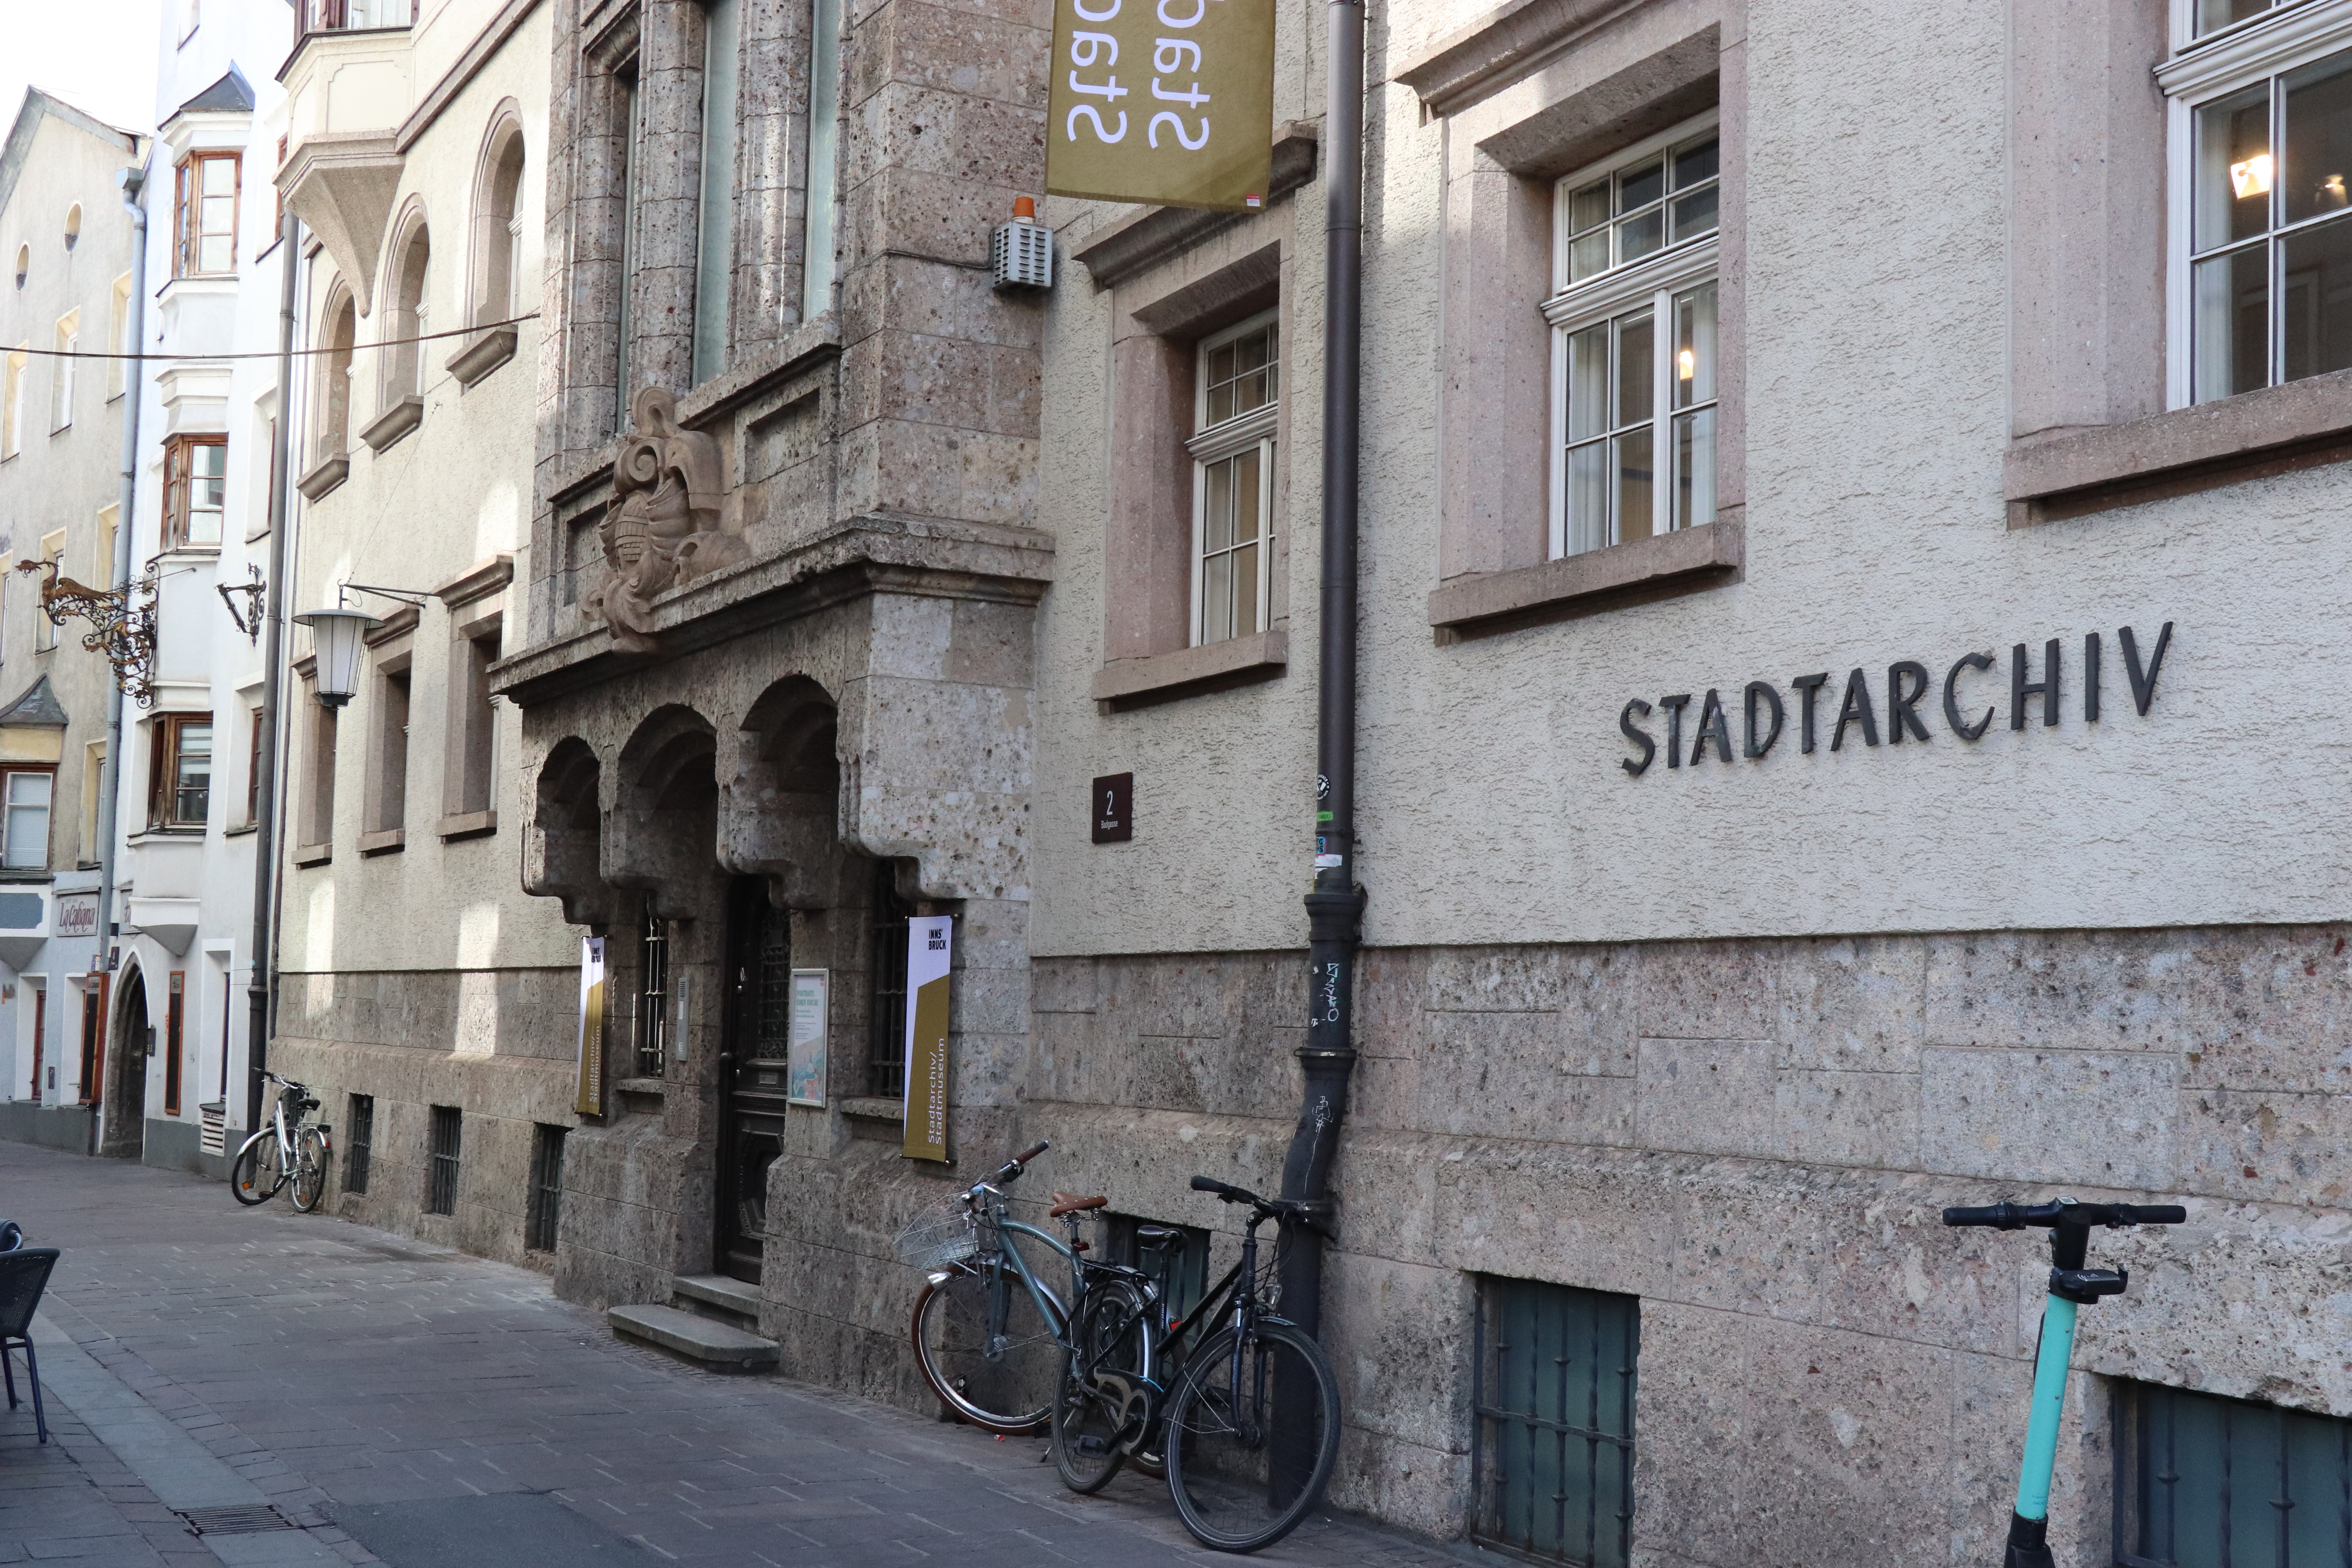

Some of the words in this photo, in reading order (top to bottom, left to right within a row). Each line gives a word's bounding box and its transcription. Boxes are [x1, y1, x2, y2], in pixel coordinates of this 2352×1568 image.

[1619, 621, 2174, 775] STADTARCHIV
[1101, 820, 1118, 830] Badgasse
[1106, 790, 1113, 815] 2
[928, 939, 946, 951] BRUCK
[928, 1051, 937, 1143] Stadtarchiv/
[935, 1038, 944, 1145] Stadtmuseum
